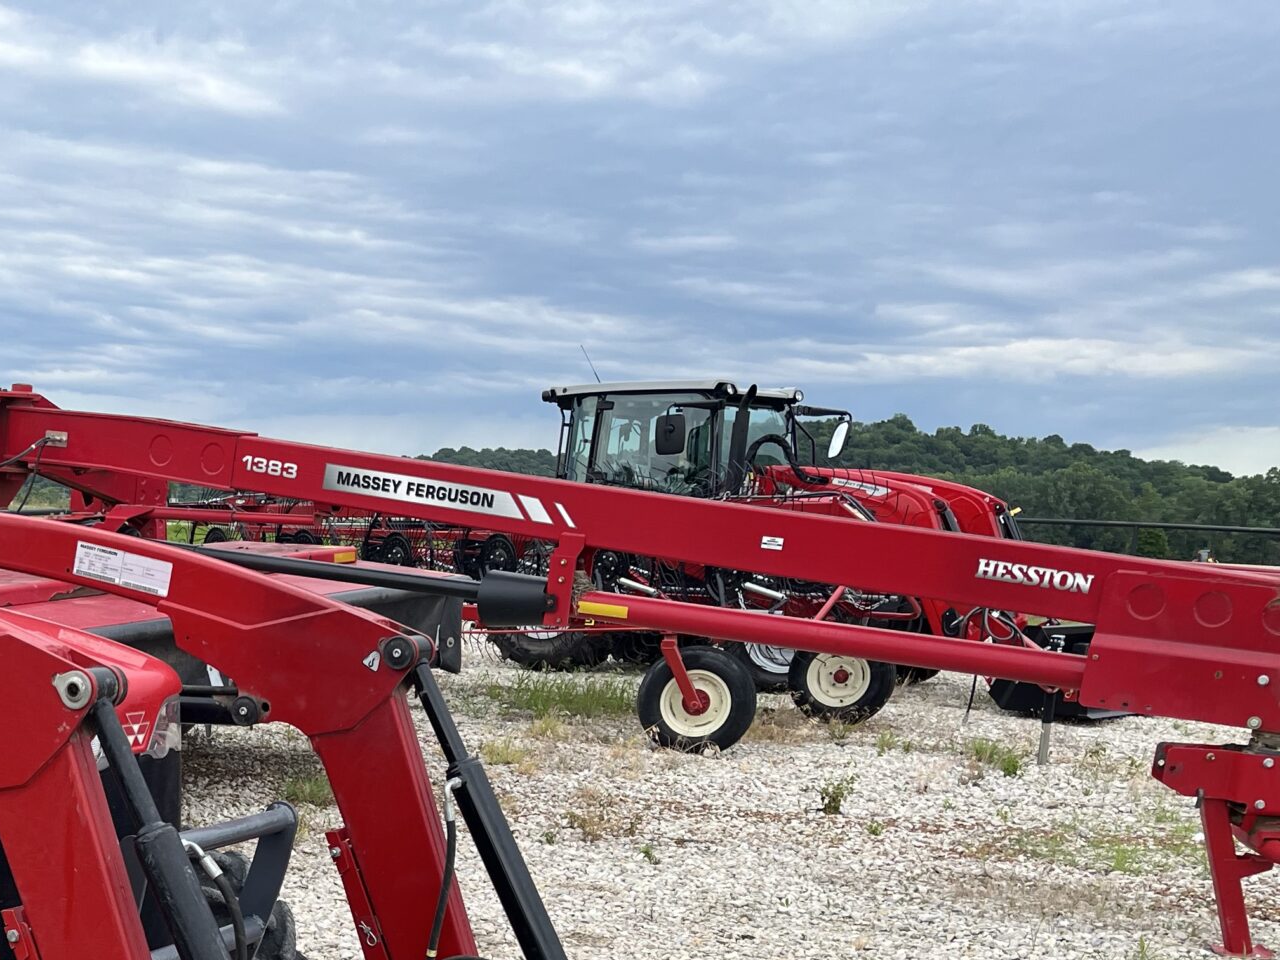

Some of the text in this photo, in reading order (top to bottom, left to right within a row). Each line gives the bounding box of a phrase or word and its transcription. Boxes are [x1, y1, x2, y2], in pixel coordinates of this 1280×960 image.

[242, 455, 298, 479] 1383
[336, 470, 495, 508] MASSEY FERGUSON
[975, 558, 1095, 594] HESSTON
